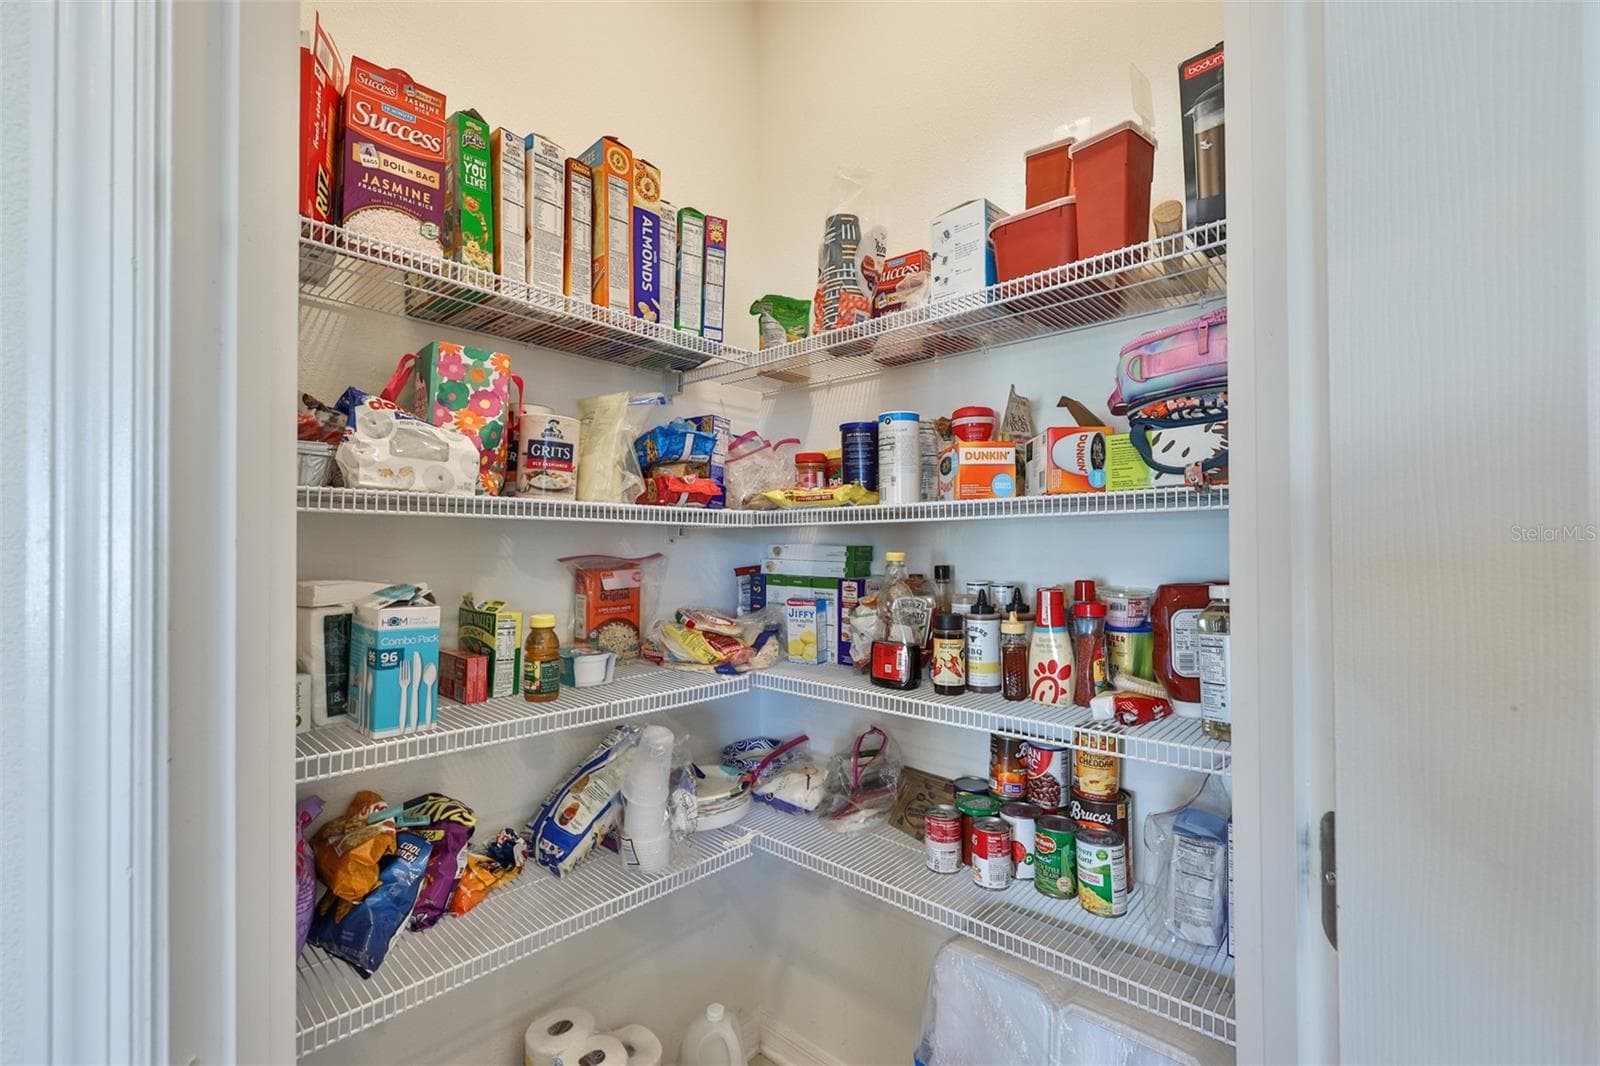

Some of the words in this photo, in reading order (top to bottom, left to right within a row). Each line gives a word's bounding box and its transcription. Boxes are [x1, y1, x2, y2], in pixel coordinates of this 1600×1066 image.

[1189, 54, 1224, 75] bodum
[357, 72, 396, 96] Success
[404, 96, 440, 115] JASMINE
[352, 101, 442, 152] Success
[362, 158, 378, 166] BAGS
[383, 159, 406, 174] BOIL
[416, 170, 436, 183] BAG
[464, 161, 486, 180] YOU
[316, 163, 329, 219] RITZ
[358, 182, 397, 200] FRAGRANT
[399, 194, 416, 206] THAI
[418, 202, 433, 212] RICE
[362, 172, 431, 204] JASMINE
[642, 214, 653, 292] ALMONDS
[530, 444, 570, 460] GRITS
[600, 591, 630, 602] Original
[788, 608, 814, 618] JIFFY
[474, 613, 495, 634] VALLEY
[381, 636, 416, 646] Combo
[418, 634, 440, 644] Pack
[380, 652, 398, 663] 96
[1078, 756, 1114, 768] CHEDDAR
[1070, 800, 1114, 825] Bruce's
[398, 848, 417, 864] NCH
[400, 841, 421, 856] COOL
